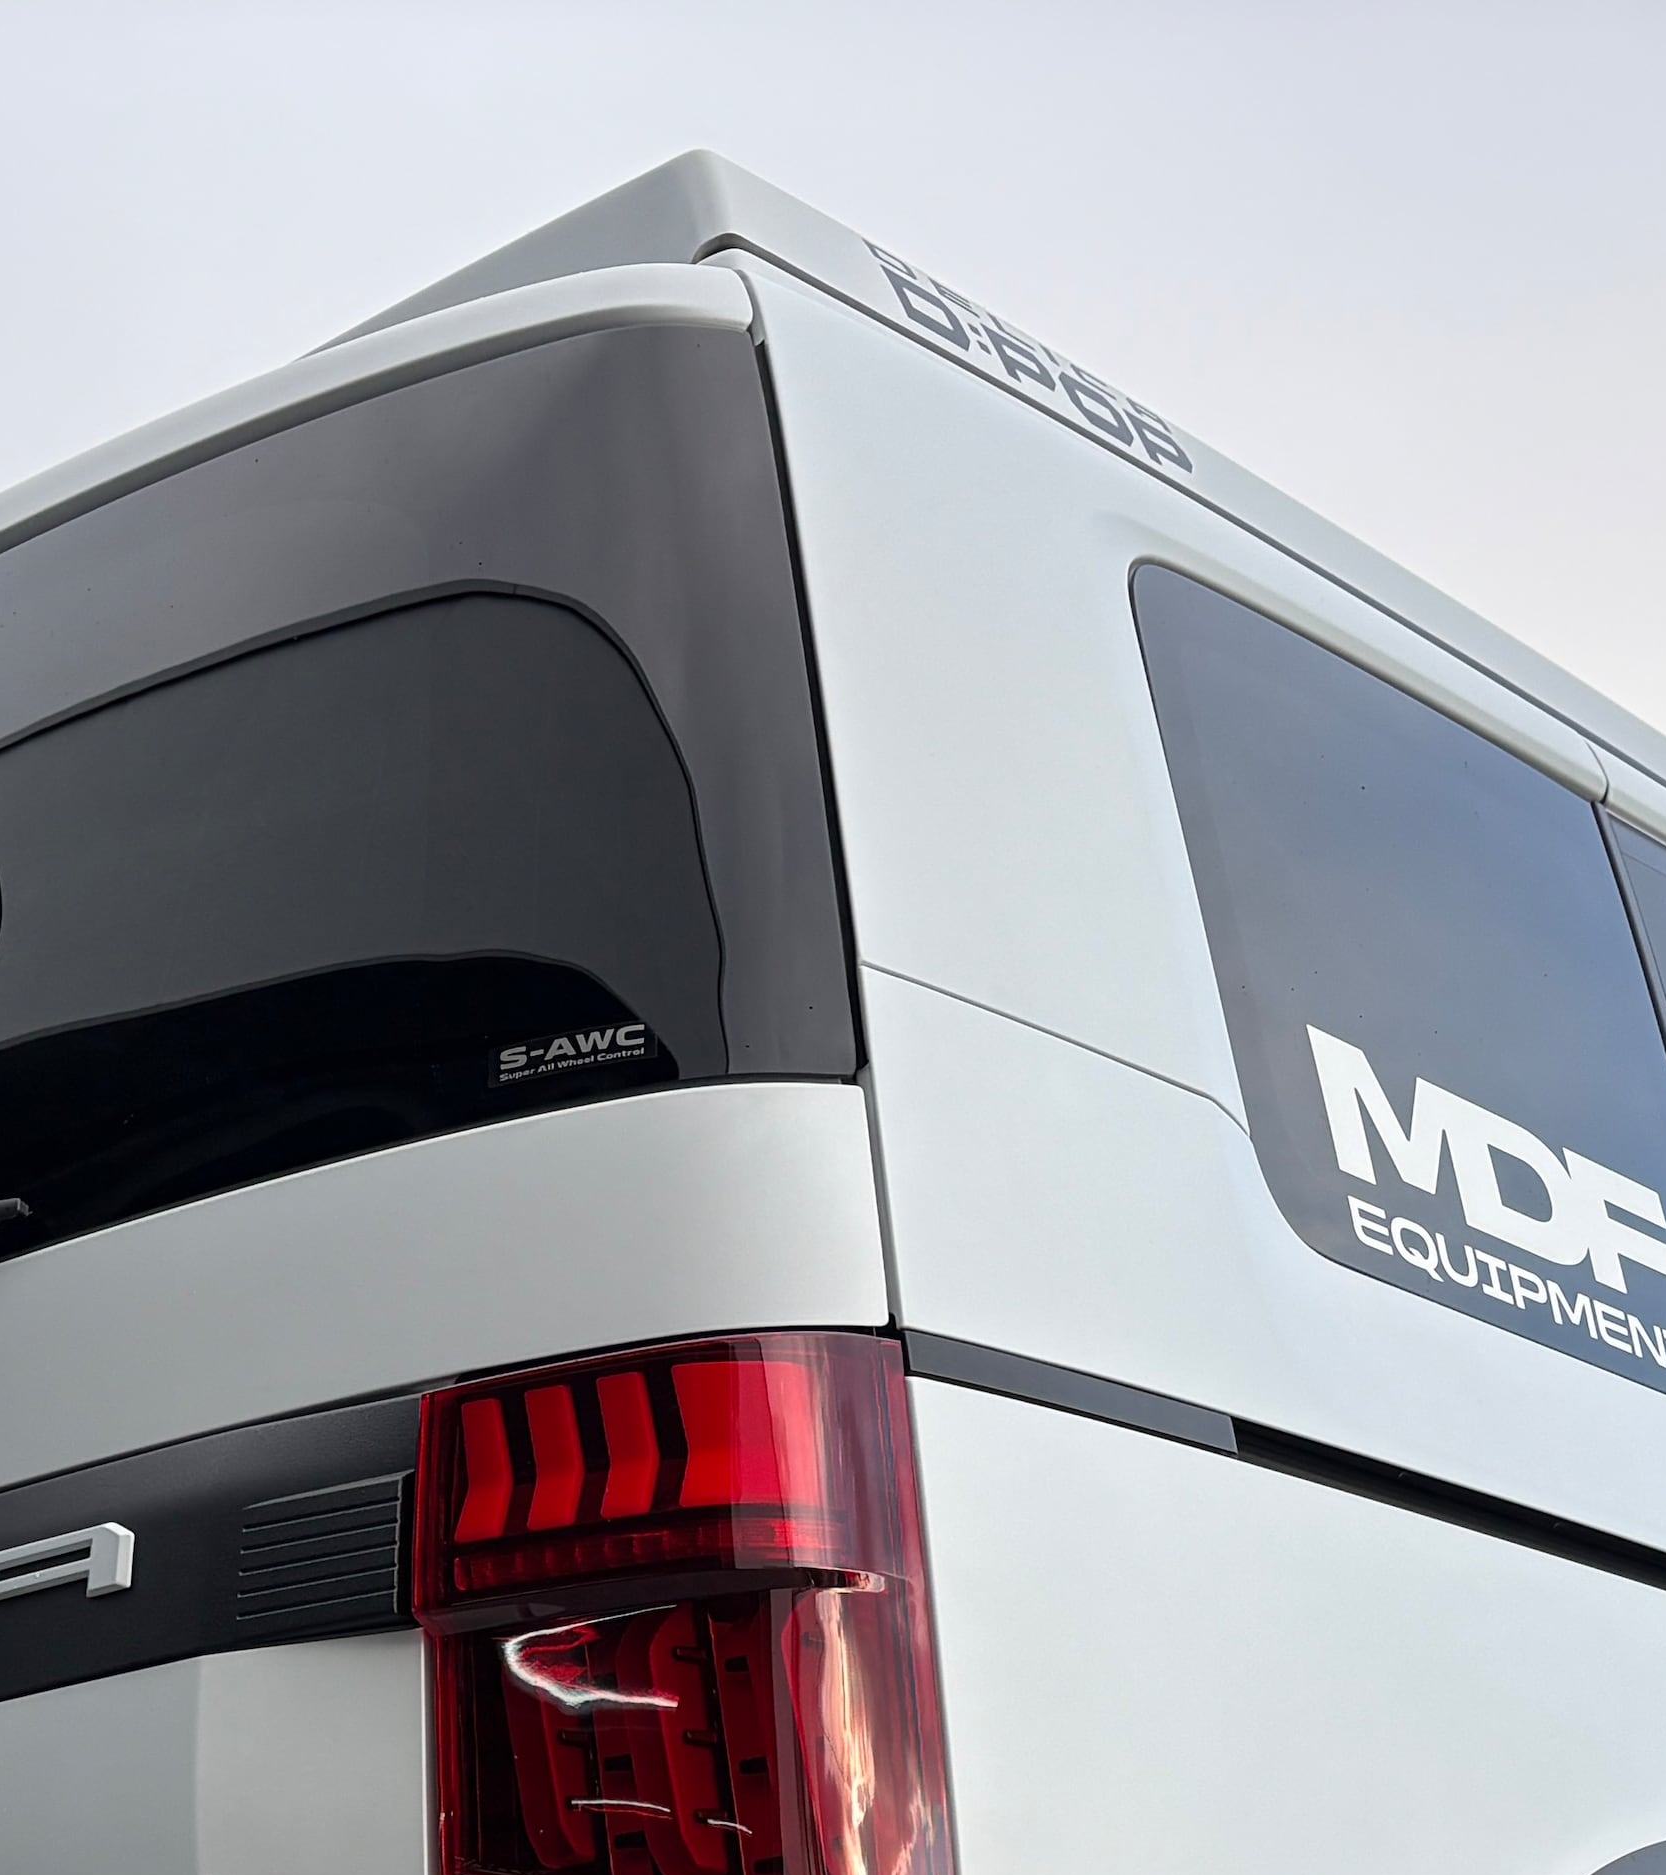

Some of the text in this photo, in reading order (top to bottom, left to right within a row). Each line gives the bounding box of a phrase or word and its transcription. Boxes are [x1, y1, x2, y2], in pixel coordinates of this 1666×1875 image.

[880, 264, 1194, 474] D:POP
[499, 1024, 645, 1071] S-AWC
[499, 1047, 645, 1082] Super All Wheel Control
